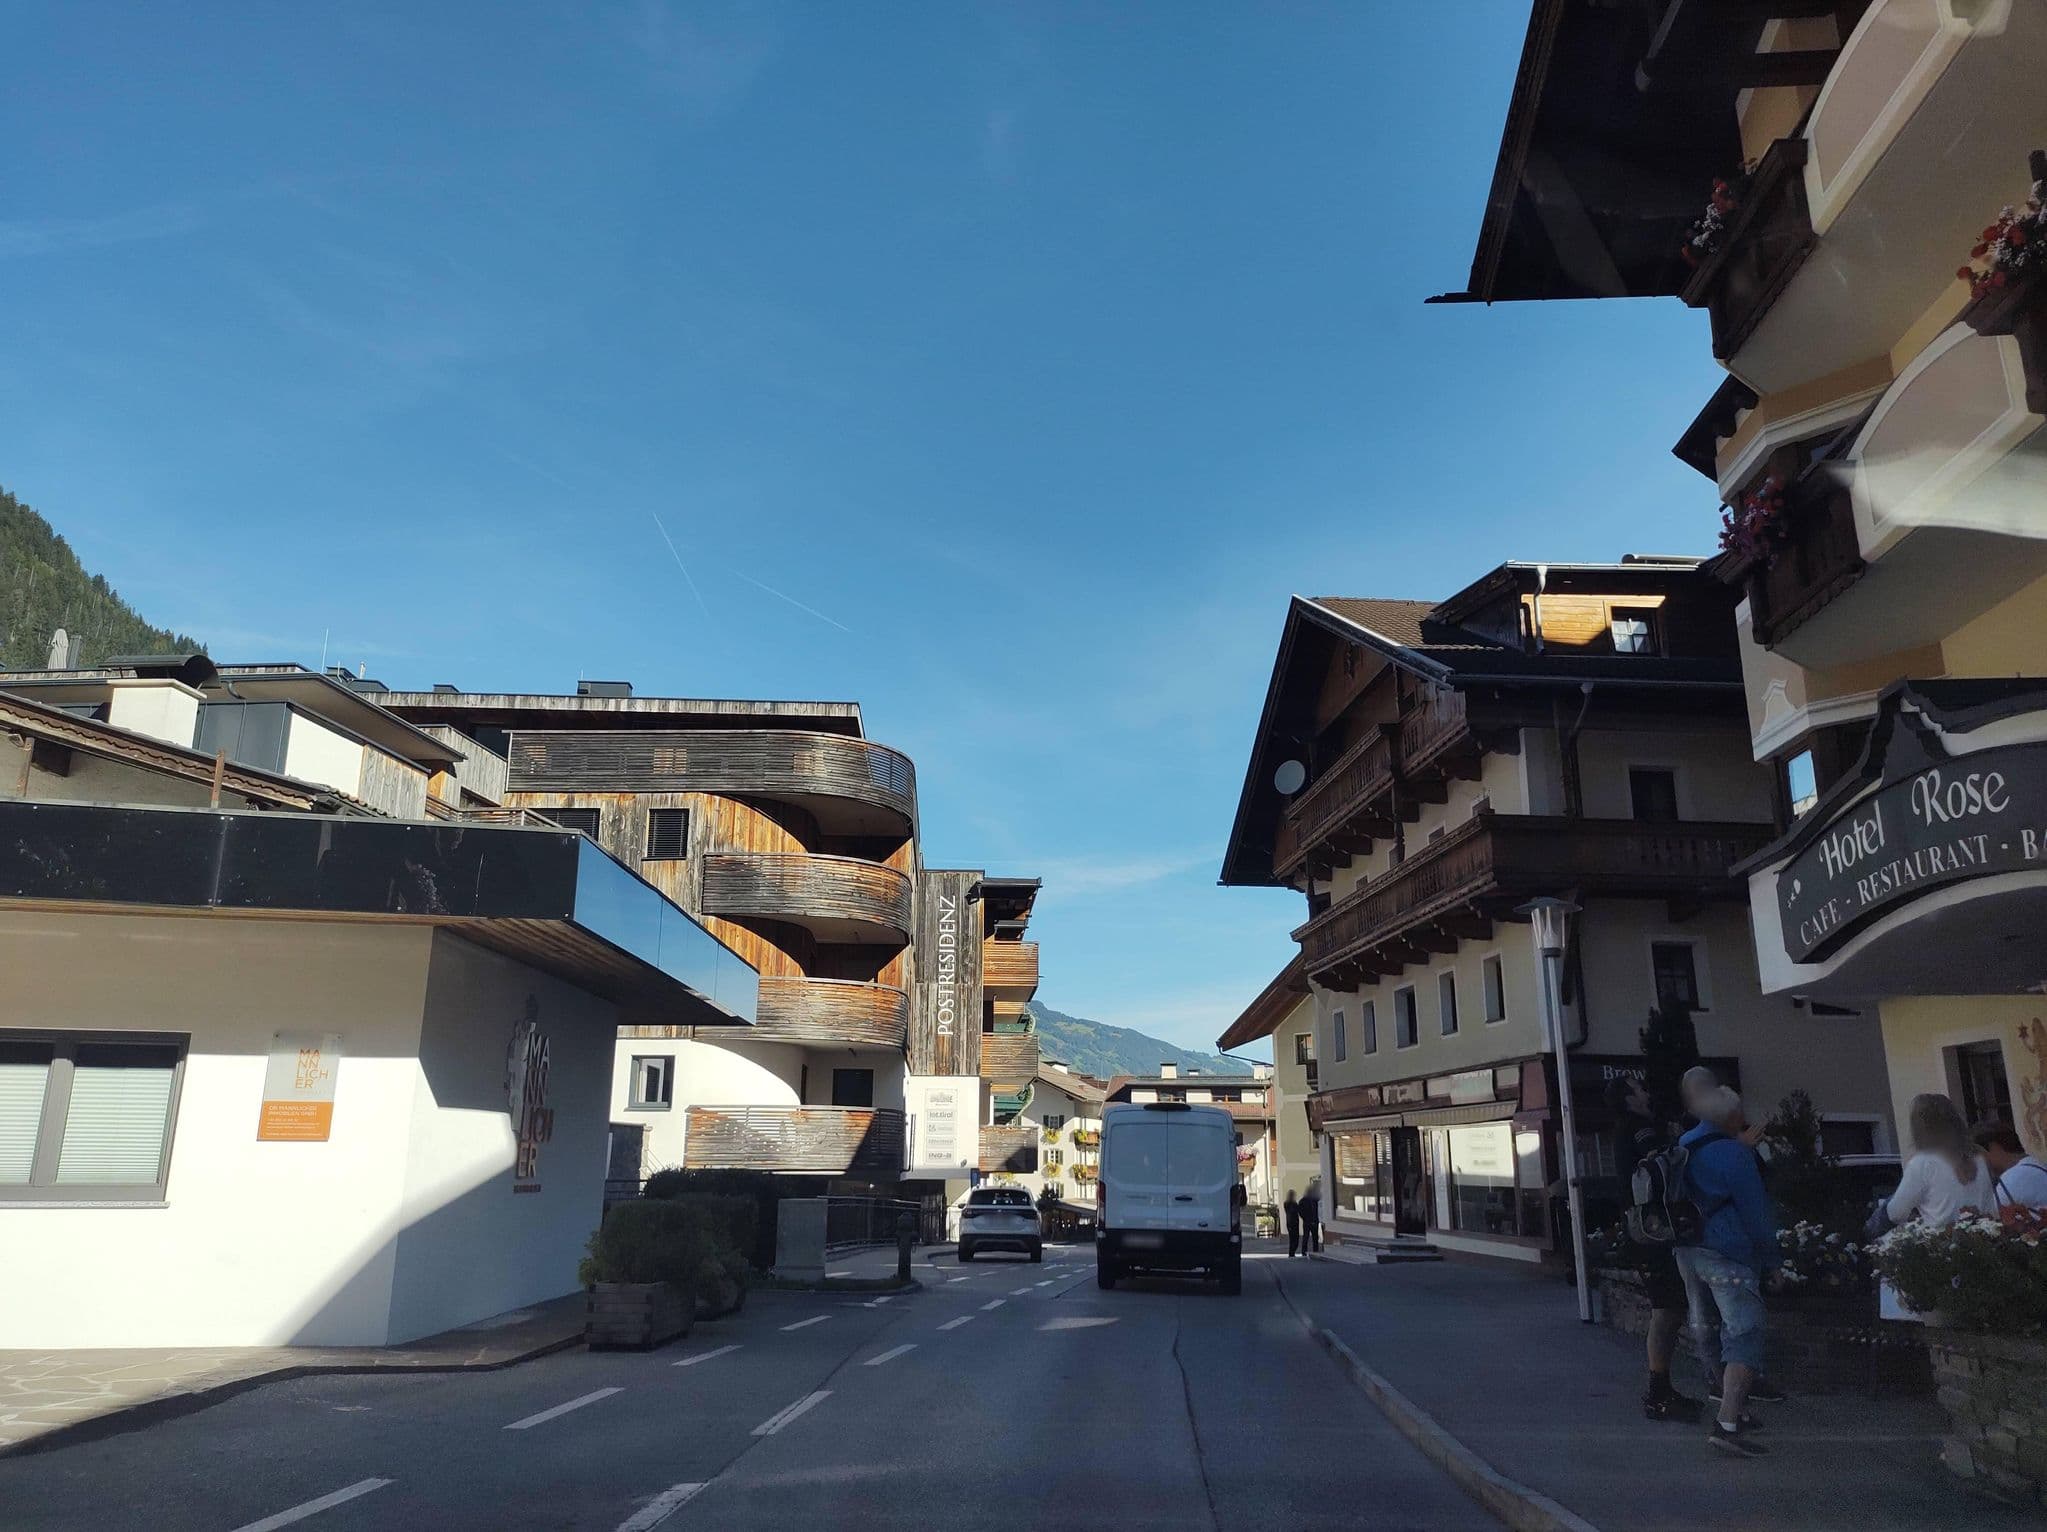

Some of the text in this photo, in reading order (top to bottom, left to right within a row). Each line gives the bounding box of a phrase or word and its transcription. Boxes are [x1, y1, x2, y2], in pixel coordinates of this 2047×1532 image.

[1818, 768, 2010, 880] Hotel Rose
[1857, 835, 1988, 906] RESTAURANT
[2020, 828, 2047, 860] B
[937, 895, 956, 1036] POSTRESIDENZ
[298, 1057, 320, 1069] NN
[300, 1048, 320, 1057] MA
[530, 1033, 551, 1069] MA
[295, 1079, 314, 1089] ER
[297, 1069, 328, 1080] LICH
